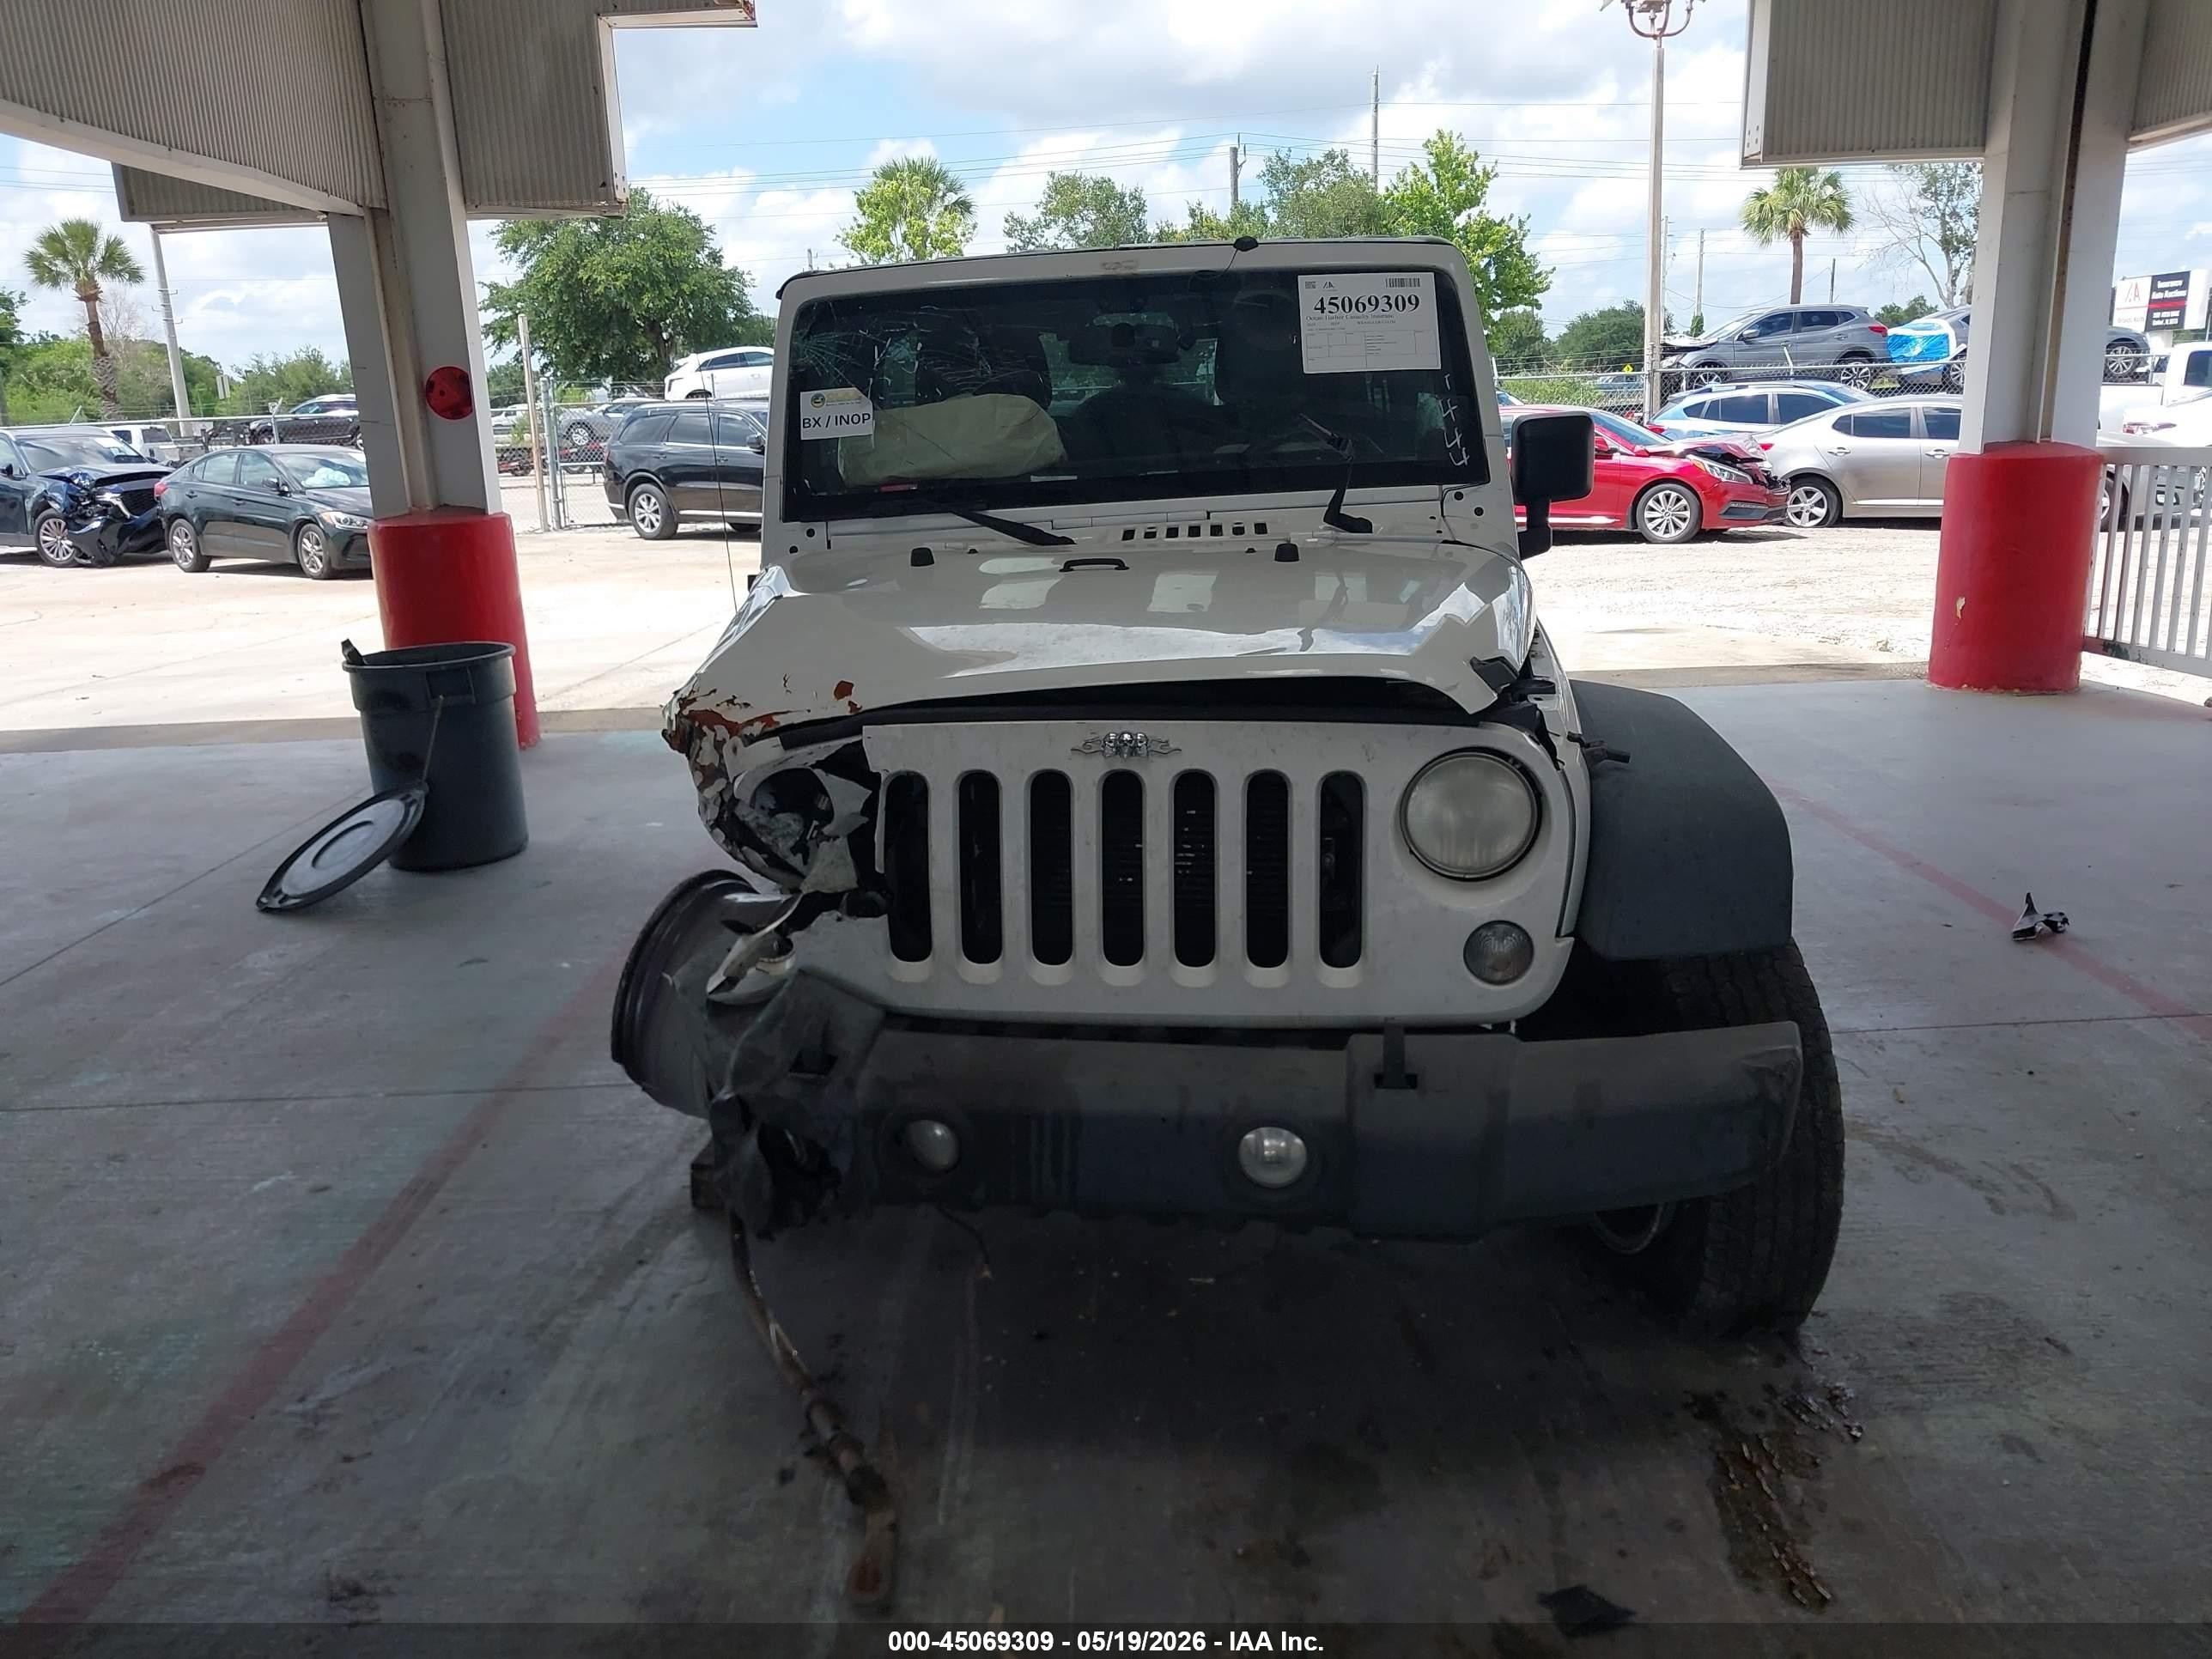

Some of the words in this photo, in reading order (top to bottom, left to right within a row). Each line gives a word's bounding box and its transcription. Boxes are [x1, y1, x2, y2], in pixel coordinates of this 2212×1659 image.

[1314, 295, 1420, 314] 45069309
[803, 417, 822, 428] BX
[825, 415, 831, 428] /
[836, 413, 871, 426] INOP
